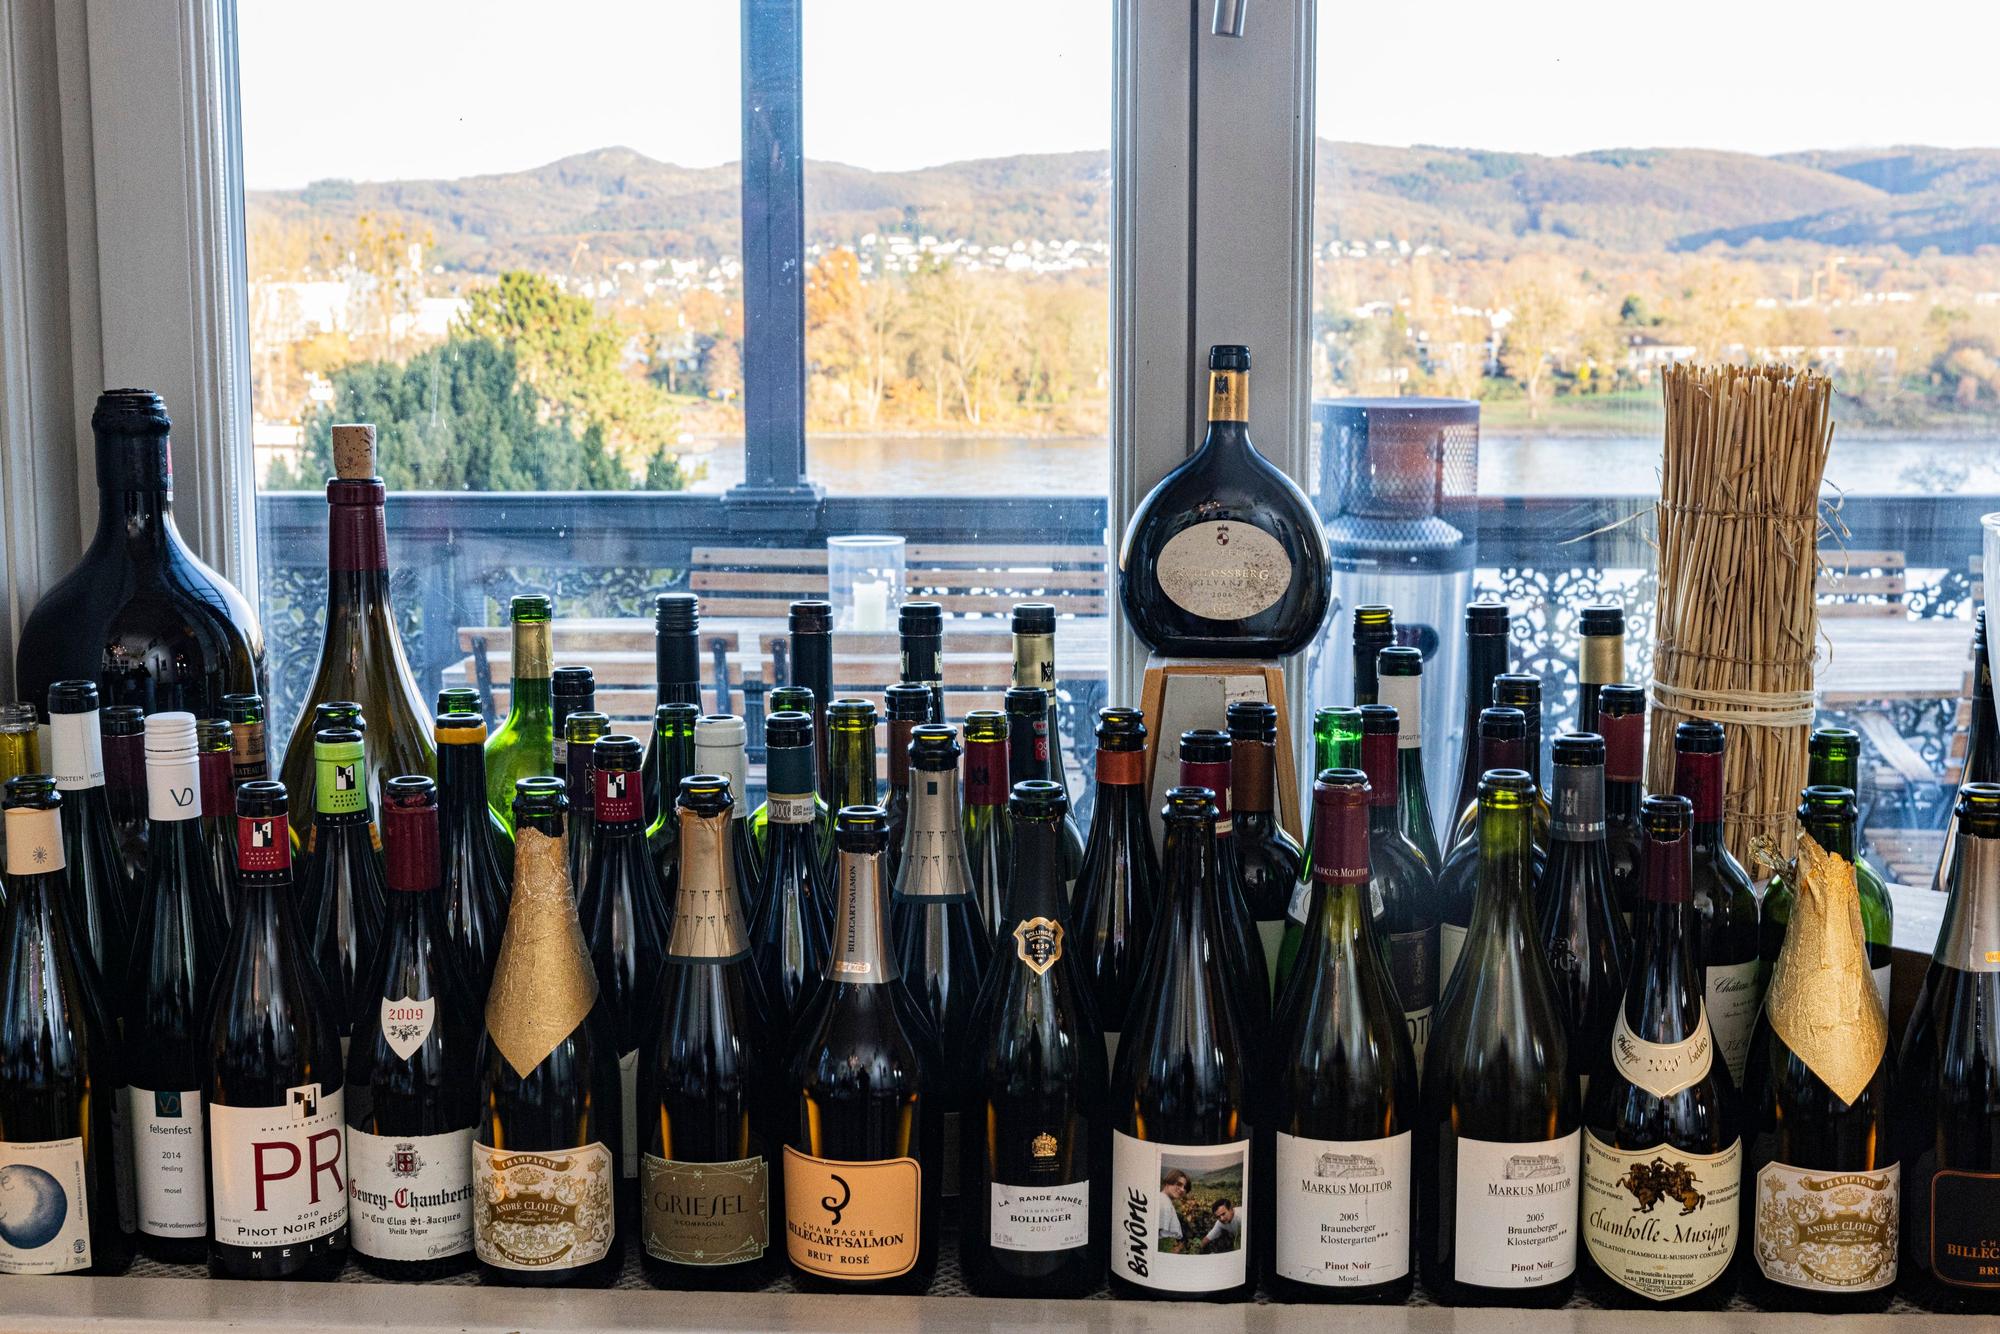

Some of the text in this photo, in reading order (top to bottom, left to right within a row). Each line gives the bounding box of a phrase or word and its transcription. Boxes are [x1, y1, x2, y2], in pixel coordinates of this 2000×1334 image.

[387, 1008, 424, 1021] 2009
[1647, 1056, 1681, 1073] 2008
[149, 1124, 192, 1135] felsenfest
[161, 1151, 182, 1159] 2014
[161, 1165, 183, 1173] riesling
[501, 1155, 558, 1170] CHAMPAGNE
[251, 1128, 345, 1212] PR
[1301, 1179, 1393, 1194] MARKUS MOLITOR
[1487, 1178, 1571, 1196] MARKUS MOLITOR
[1820, 1175, 1876, 1189] CHAMPAGNE
[349, 1178, 474, 1212] Gevrey-Chamberti
[998, 1200, 1010, 1208] LA
[1055, 1195, 1083, 1206] ANNÉE
[495, 1201, 568, 1215] ANDRÉ CLOUET
[297, 1209, 320, 1221] 2010
[370, 1214, 385, 1225] Cru
[386, 1216, 407, 1226] Clos
[1010, 1214, 1072, 1223] BOLLINGER
[1339, 1212, 1359, 1221] 2005
[1526, 1212, 1545, 1223] 2005
[237, 1226, 278, 1238] PINOT
[283, 1220, 316, 1235] NOIR
[788, 1220, 904, 1249] BILLECART-SALMON
[802, 1221, 875, 1237] CHAMPAGNE
[1320, 1223, 1376, 1233] Brauneberger
[1507, 1223, 1558, 1235] Brauneberger
[1807, 1221, 1880, 1235] ANDRÉ CLOUET
[1591, 1237, 1626, 1254] APPELLATION
[1626, 1249, 1699, 1260] CHAMBOLLE-MUSIGNY
[807, 1248, 870, 1264] BRUT ROSÉ
[1325, 1261, 1372, 1270] Pinot Noir
[1511, 1260, 1554, 1272] Pinot Noir
[1338, 1274, 1359, 1282] Mosel
[1523, 1275, 1543, 1283] Mosel
